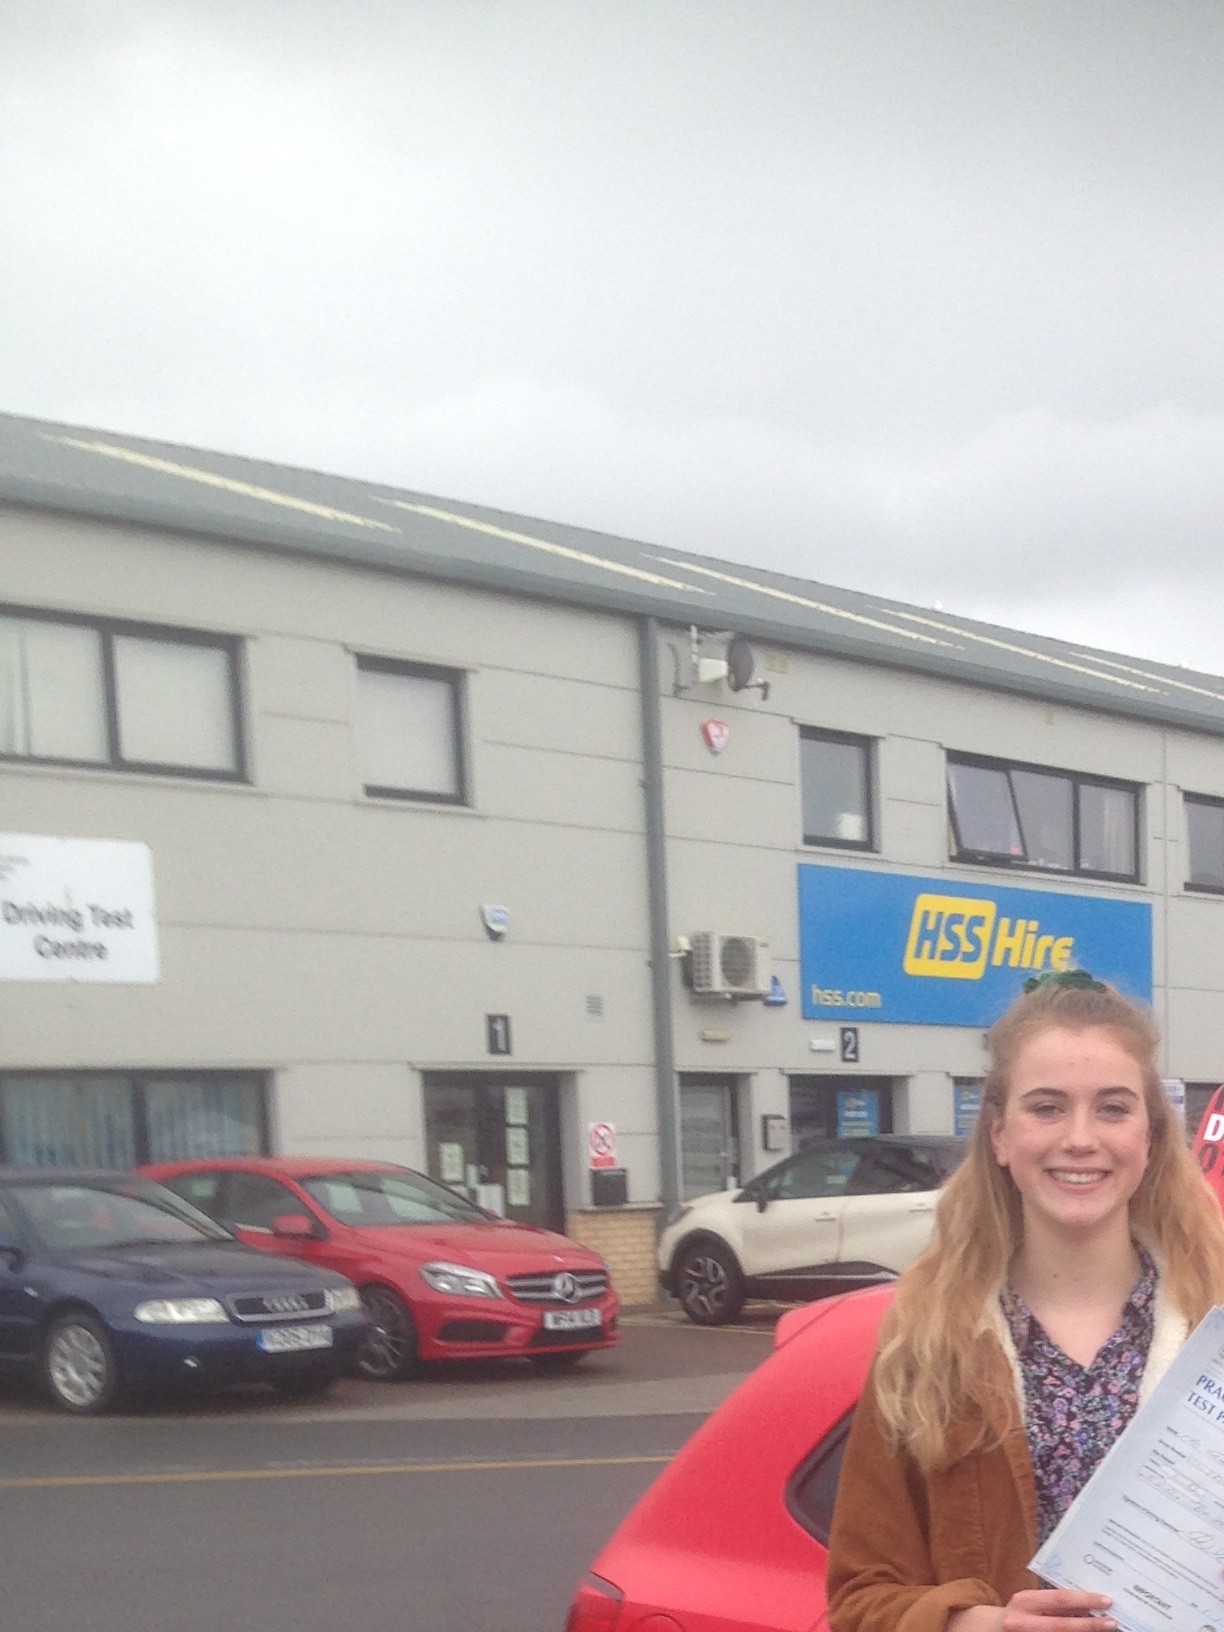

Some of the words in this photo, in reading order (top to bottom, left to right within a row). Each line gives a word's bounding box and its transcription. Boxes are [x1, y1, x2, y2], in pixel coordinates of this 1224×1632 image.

[2, 901, 84, 932] Driving
[86, 903, 134, 929] Test
[33, 935, 109, 960] Centre
[914, 910, 987, 963] HSS
[992, 917, 1075, 972] Hire
[811, 984, 882, 1008] hss.com
[843, 1031, 857, 1060] 2
[1187, 1390, 1216, 1415] TEST
